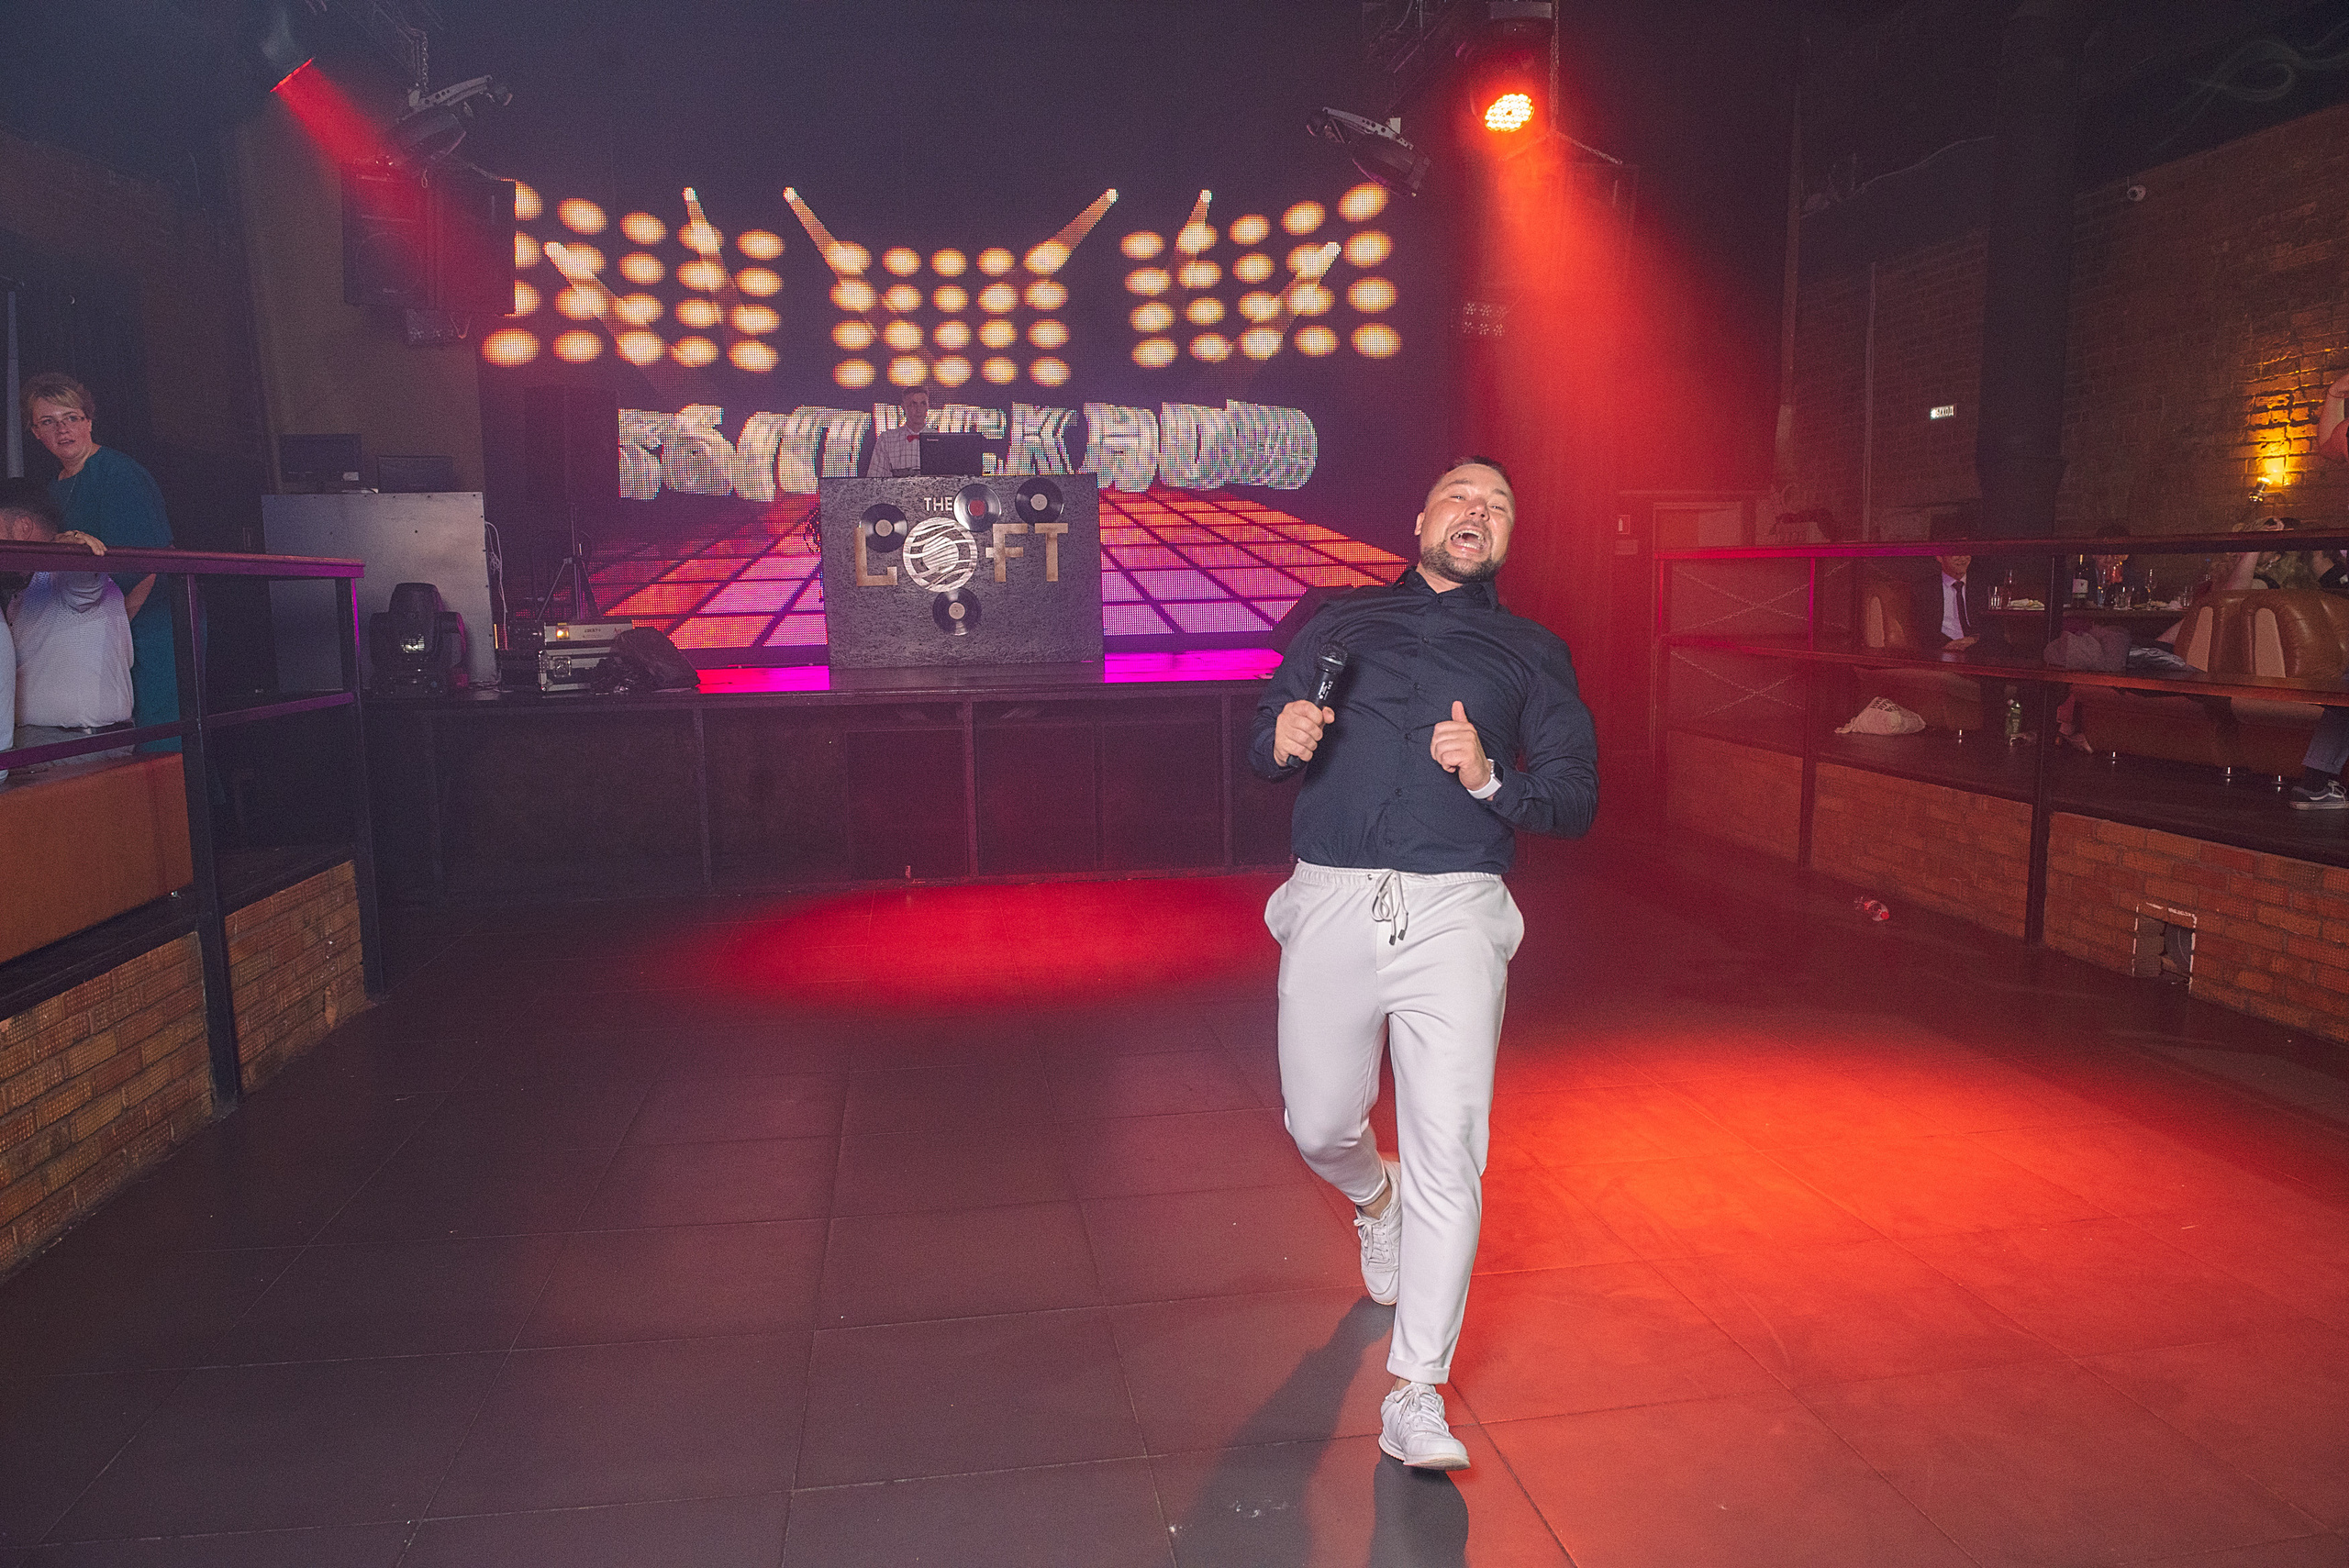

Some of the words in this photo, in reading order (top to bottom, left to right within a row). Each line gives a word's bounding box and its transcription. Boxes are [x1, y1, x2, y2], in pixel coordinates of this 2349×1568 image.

[1932, 406, 1954, 418] ЫХОД
[923, 496, 952, 512] THE
[853, 517, 1069, 593] LOFT
